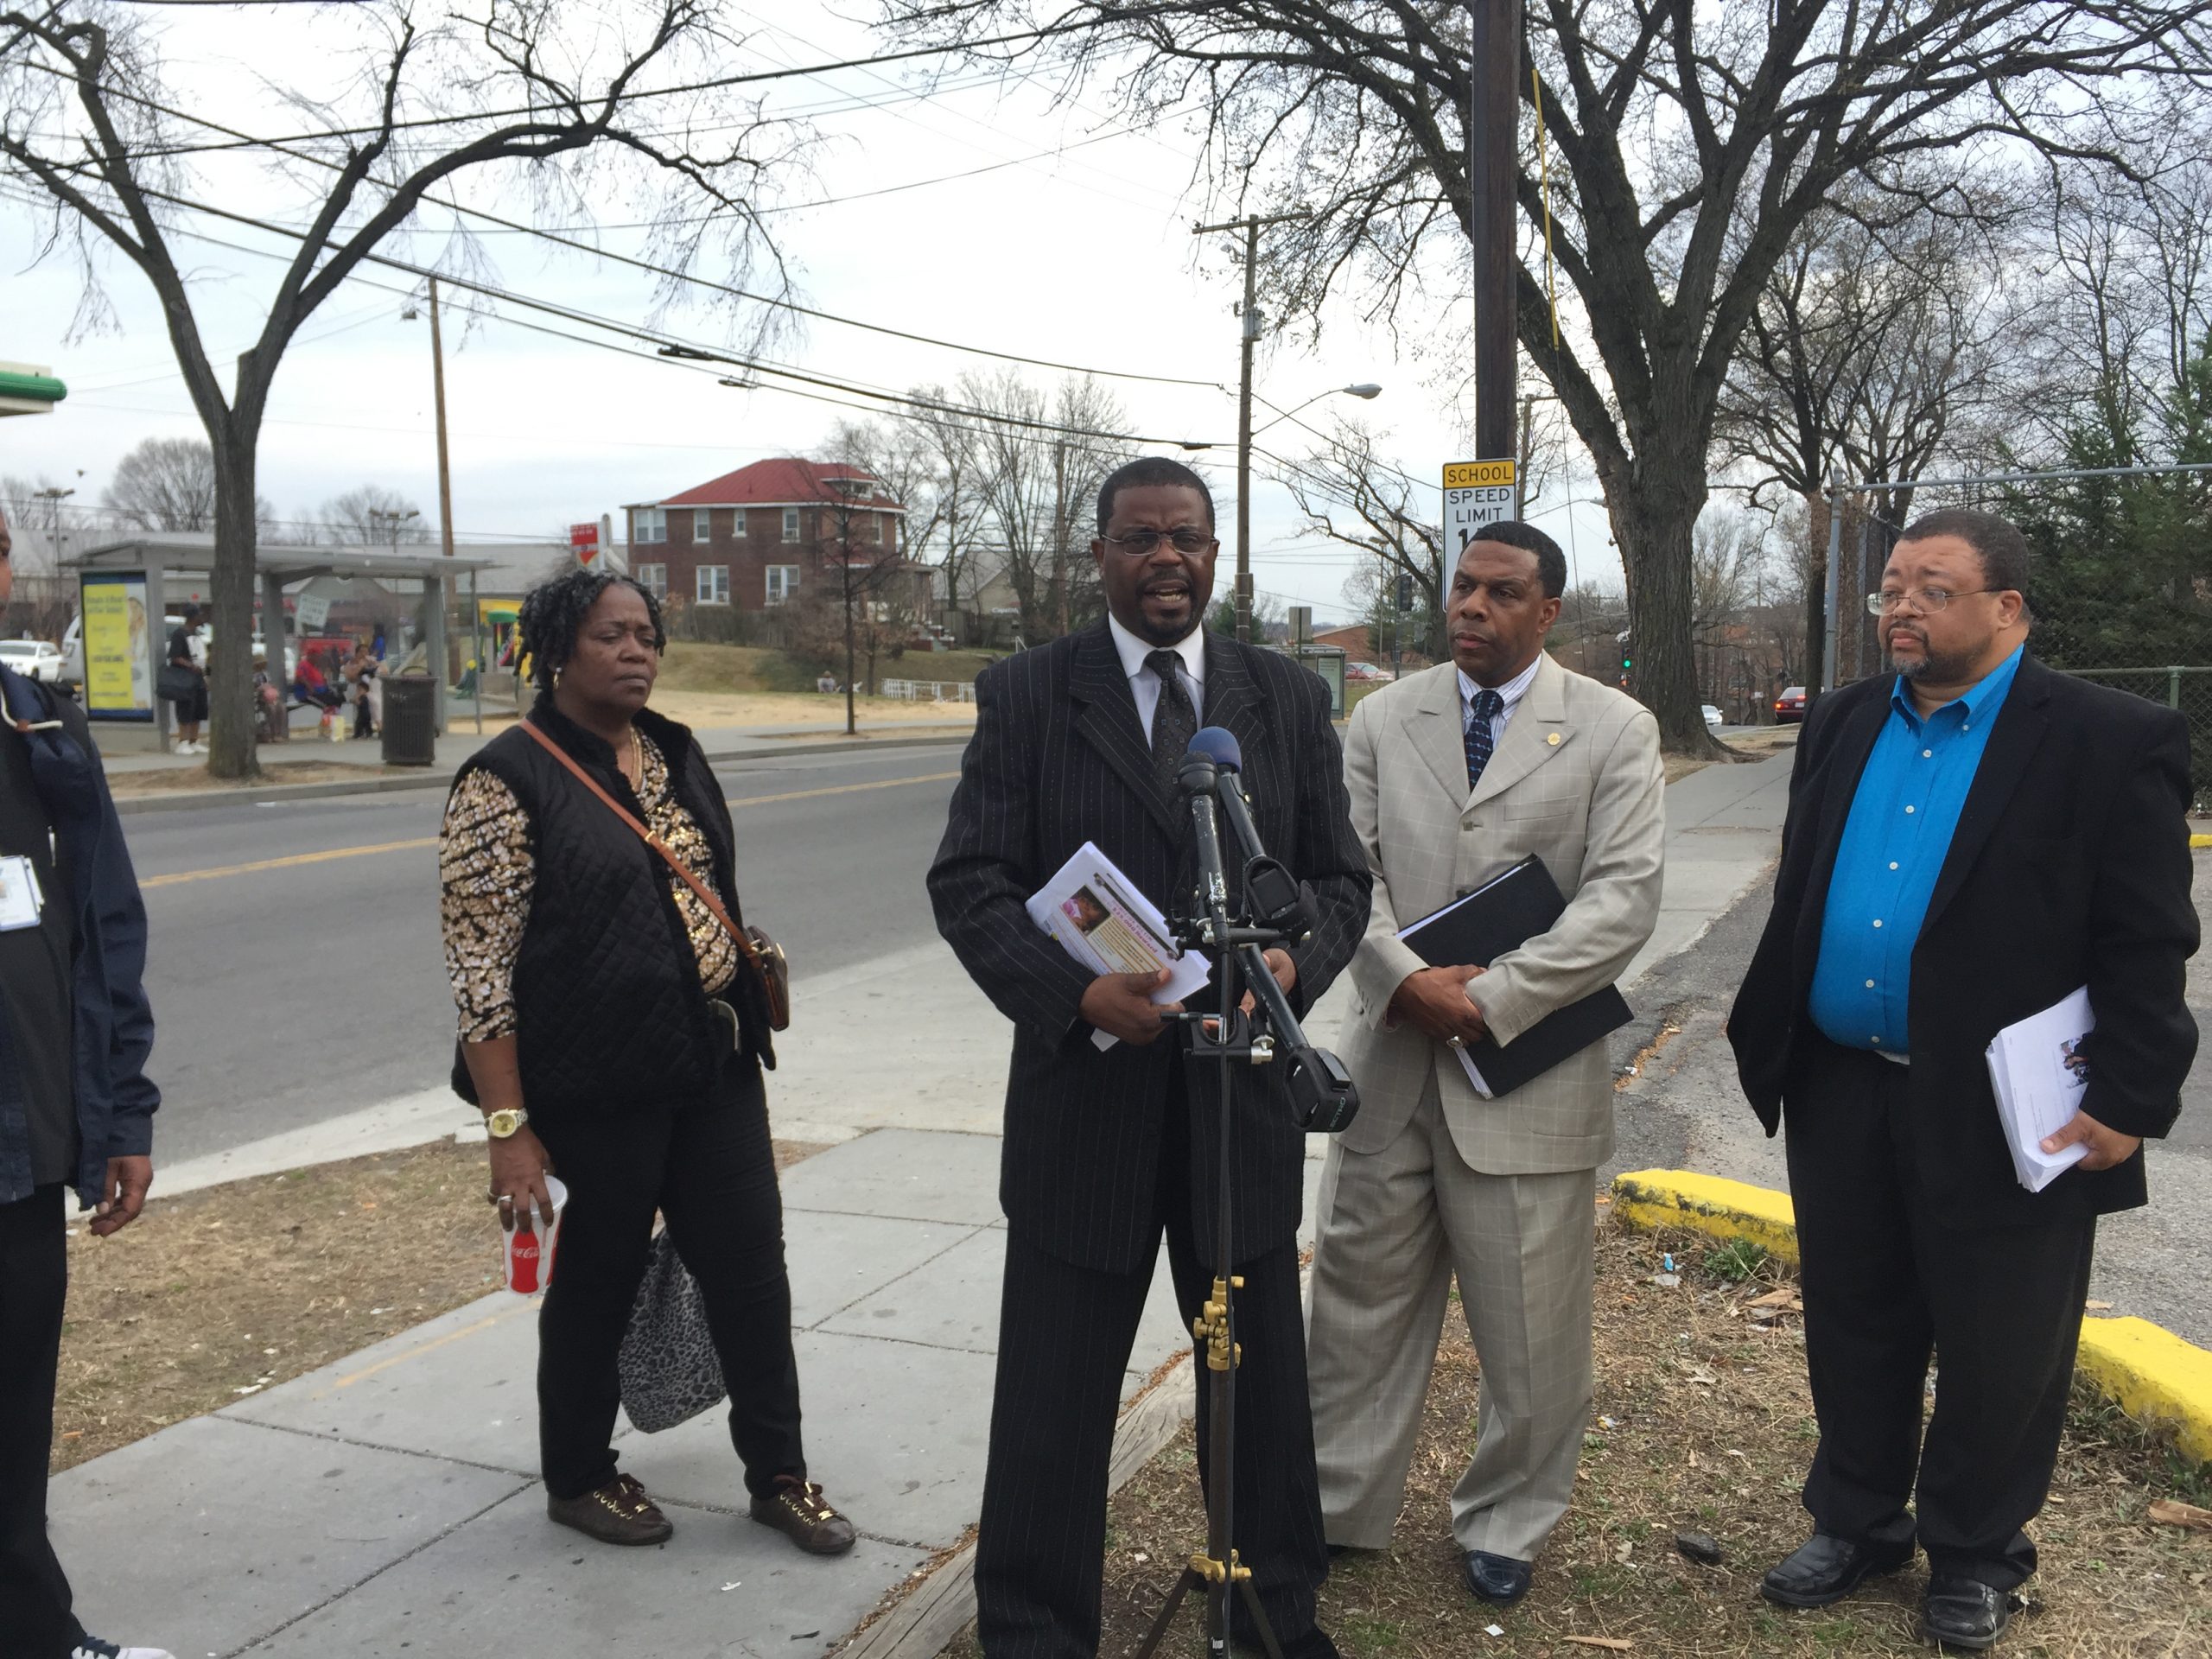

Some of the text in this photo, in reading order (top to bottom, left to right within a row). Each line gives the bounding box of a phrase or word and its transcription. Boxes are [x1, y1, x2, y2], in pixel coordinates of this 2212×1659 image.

[1448, 467, 1512, 483] SCHOOL
[1449, 488, 1510, 504] SPEED
[1456, 507, 1503, 523] LIMIT
